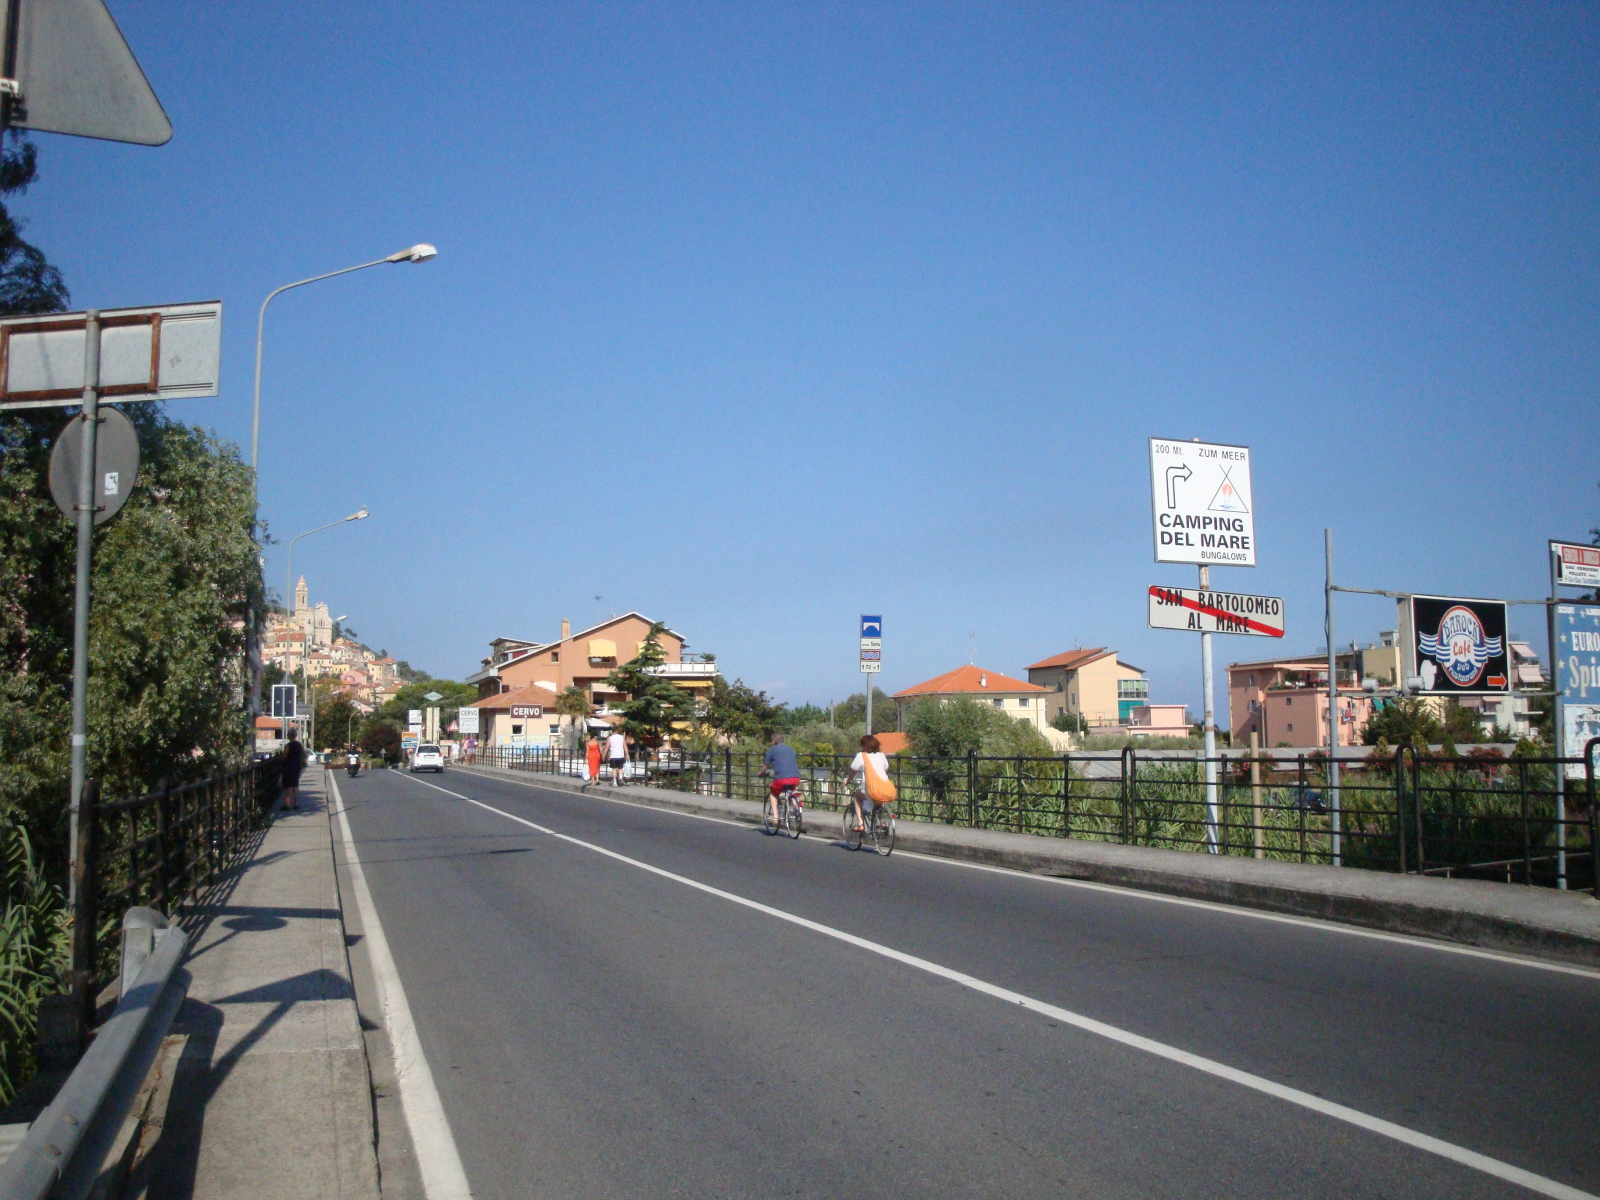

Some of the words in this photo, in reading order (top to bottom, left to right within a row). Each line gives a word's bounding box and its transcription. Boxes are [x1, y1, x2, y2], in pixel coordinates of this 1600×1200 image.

[1156, 444, 1170, 454] 200
[1199, 448, 1218, 459] ZUM
[1221, 451, 1246, 461] MEER
[1159, 513, 1244, 532] CAMPING
[1160, 531, 1195, 547] DEL
[1200, 533, 1250, 550] MARE
[1201, 551, 1247, 561] BUNGALOWS
[1156, 588, 1183, 607] SAN
[1198, 592, 1279, 615] BARTOLOMEO
[1188, 612, 1203, 629] AL
[1216, 615, 1250, 633] MARE
[1453, 640, 1471, 657] Café
[1456, 662, 1470, 671] pub
[513, 707, 540, 716] CERVO
